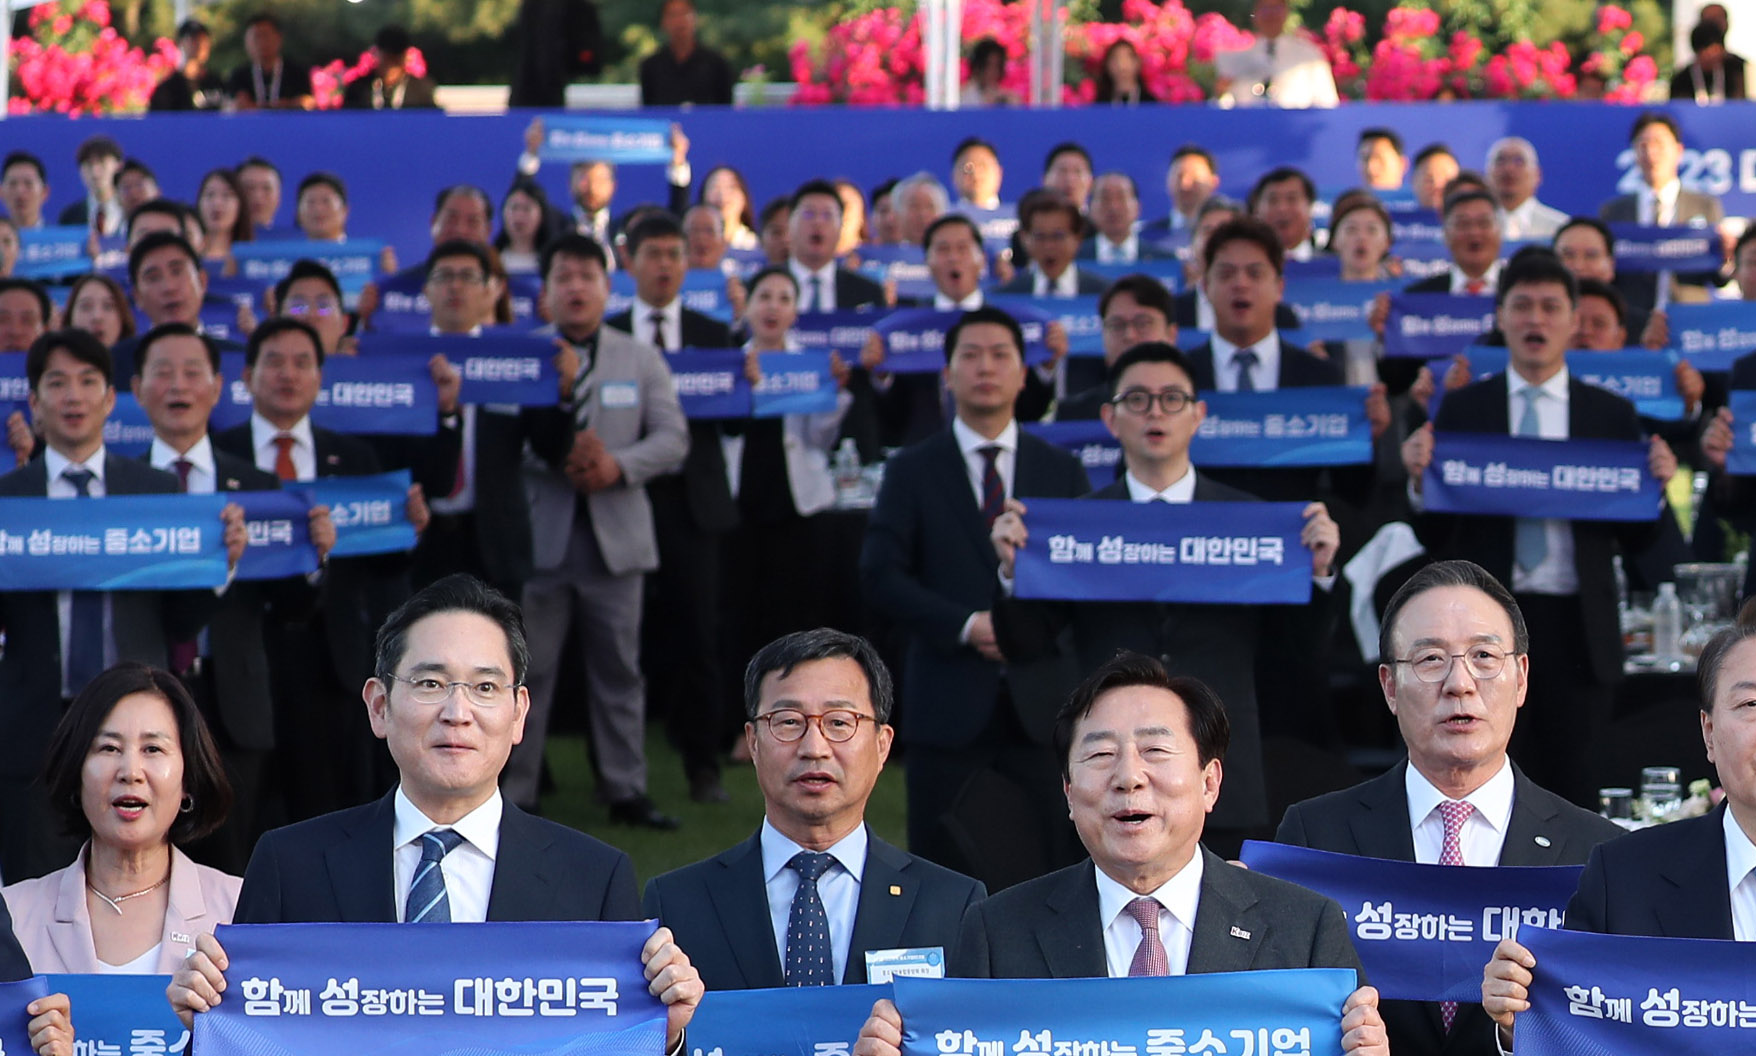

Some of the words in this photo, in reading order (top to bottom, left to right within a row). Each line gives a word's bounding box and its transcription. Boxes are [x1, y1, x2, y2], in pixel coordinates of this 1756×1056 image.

[1616, 148, 1732, 195] 223
[1552, 465, 1641, 493] 대한민국
[329, 500, 391, 525] 소기업
[28, 528, 100, 555] 성장하는
[104, 526, 200, 554] 중소기업
[1049, 535, 1093, 563] 함께
[1097, 536, 1176, 564] 성장하는
[1180, 537, 1284, 565] 대한민국
[1356, 899, 1472, 942] 성장하는
[242, 978, 311, 1016] 함께
[319, 978, 445, 1016] 성장하는
[453, 978, 619, 1017] 대한민국
[1563, 985, 1632, 1022] 함께
